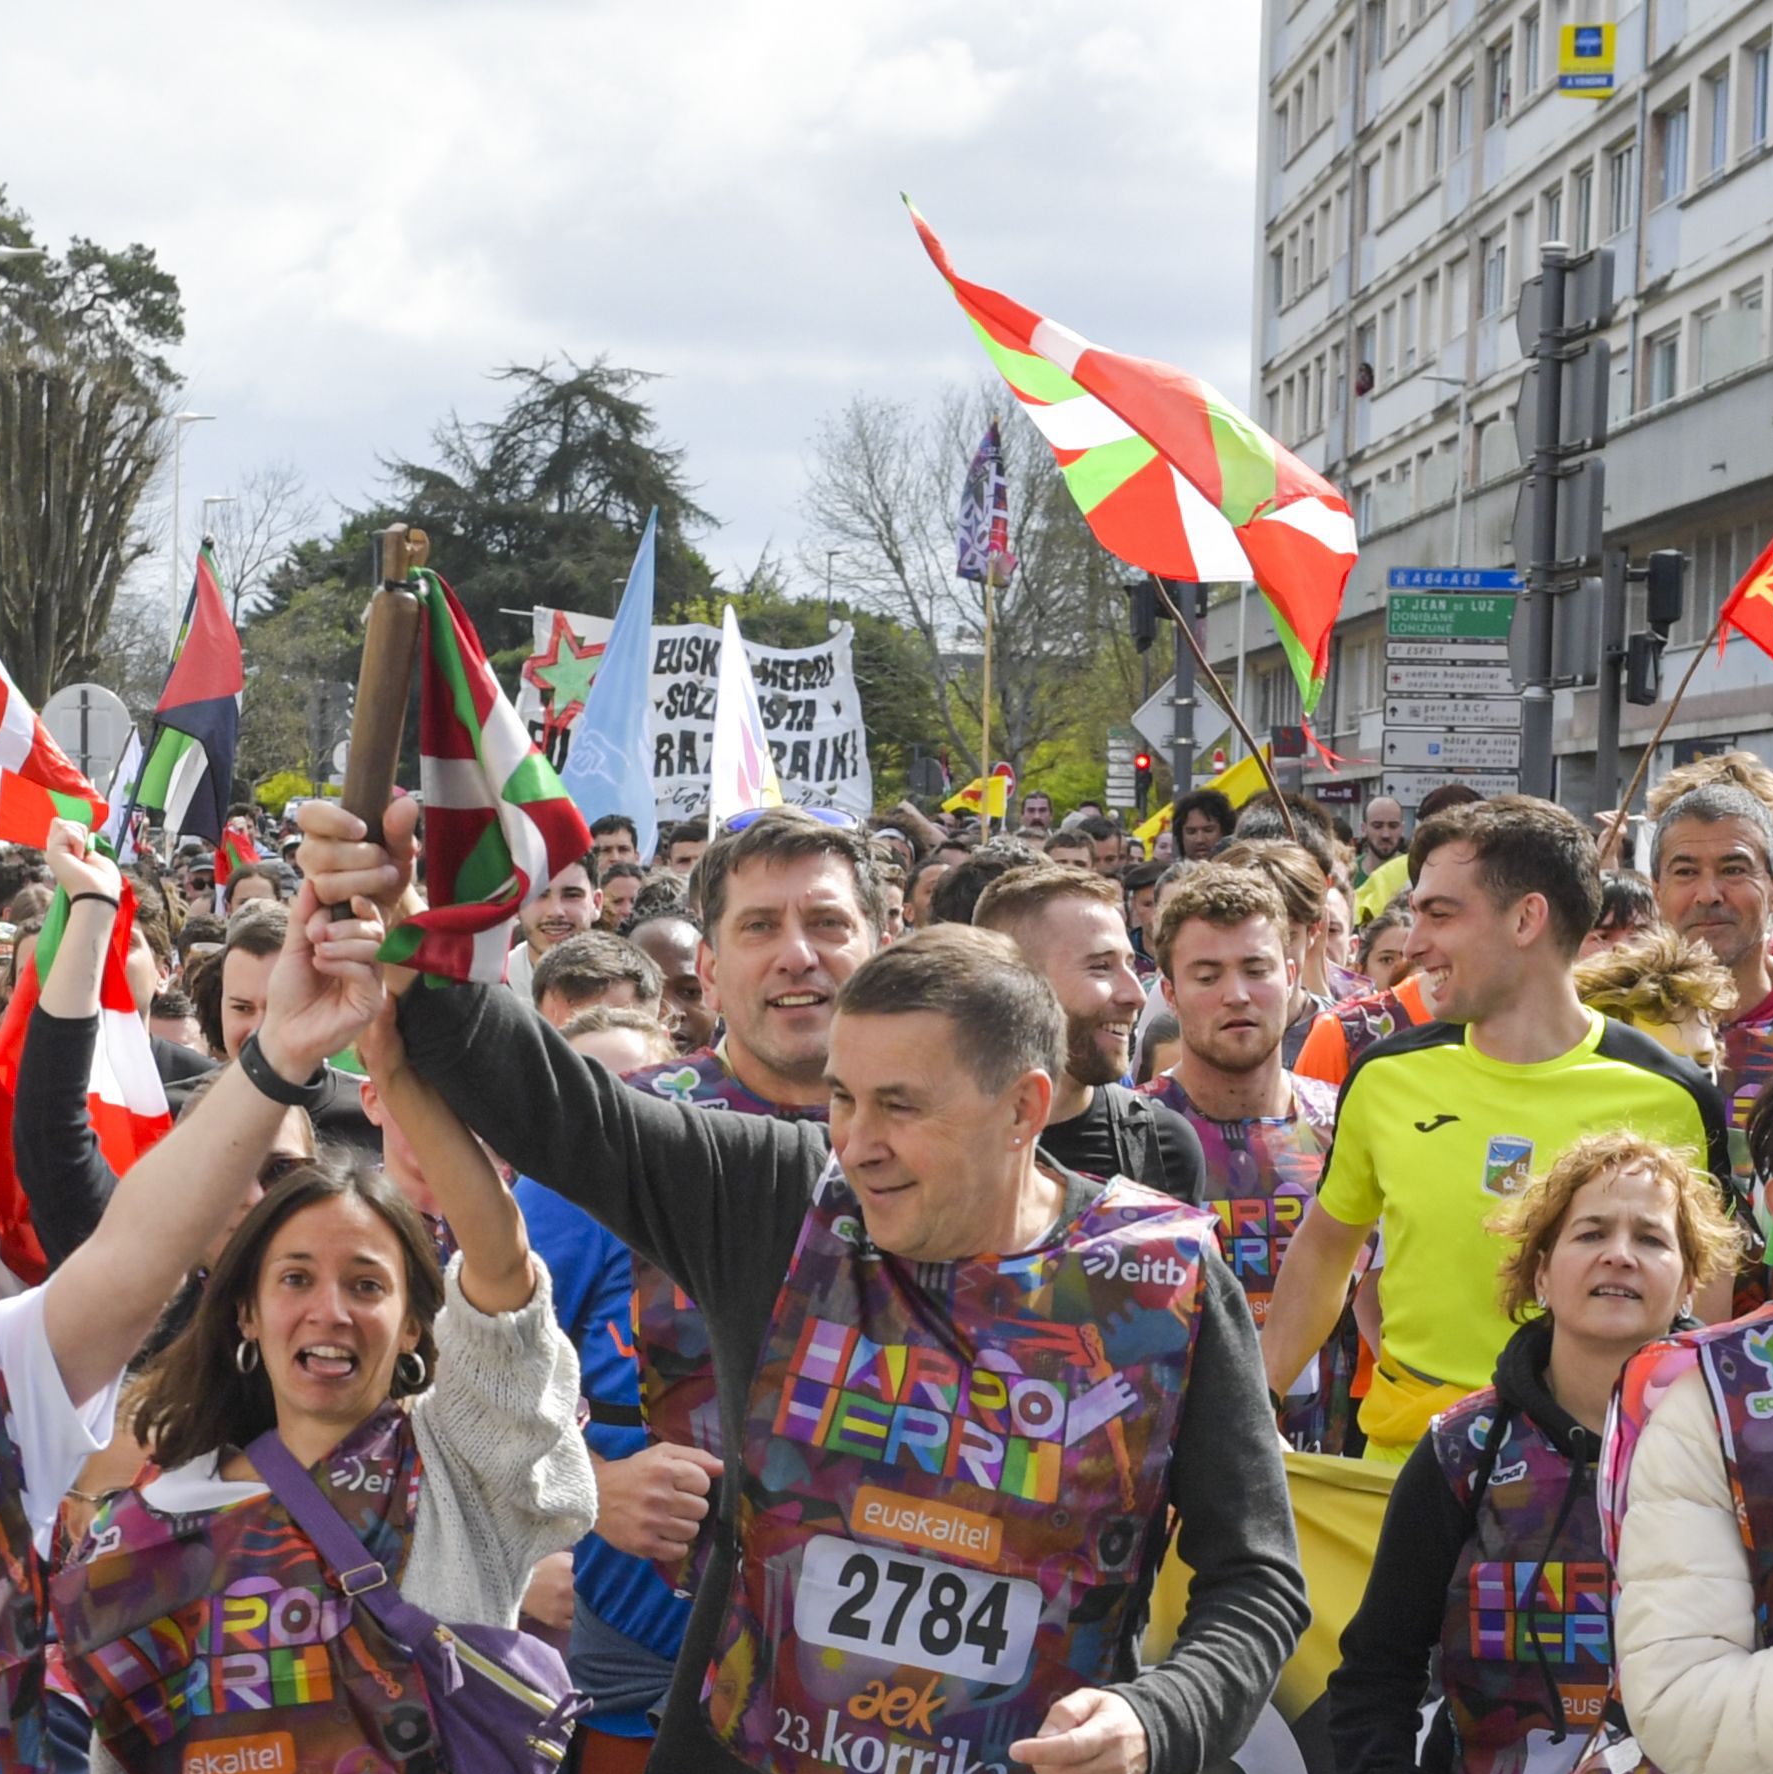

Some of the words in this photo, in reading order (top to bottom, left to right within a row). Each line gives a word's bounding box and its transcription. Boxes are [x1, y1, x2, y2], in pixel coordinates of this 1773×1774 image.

[1392, 611, 1456, 622] DONIBANE
[1412, 599, 1447, 611] JEAN
[1471, 600, 1495, 612] LUZ
[1392, 623, 1453, 633] LOHIZUNE
[1406, 646, 1445, 656] ESPRIT
[1120, 1255, 1188, 1287] eitb
[863, 1500, 993, 1552] euskaltel
[827, 1553, 1011, 1666] 2784
[847, 1675, 947, 1736] aek
